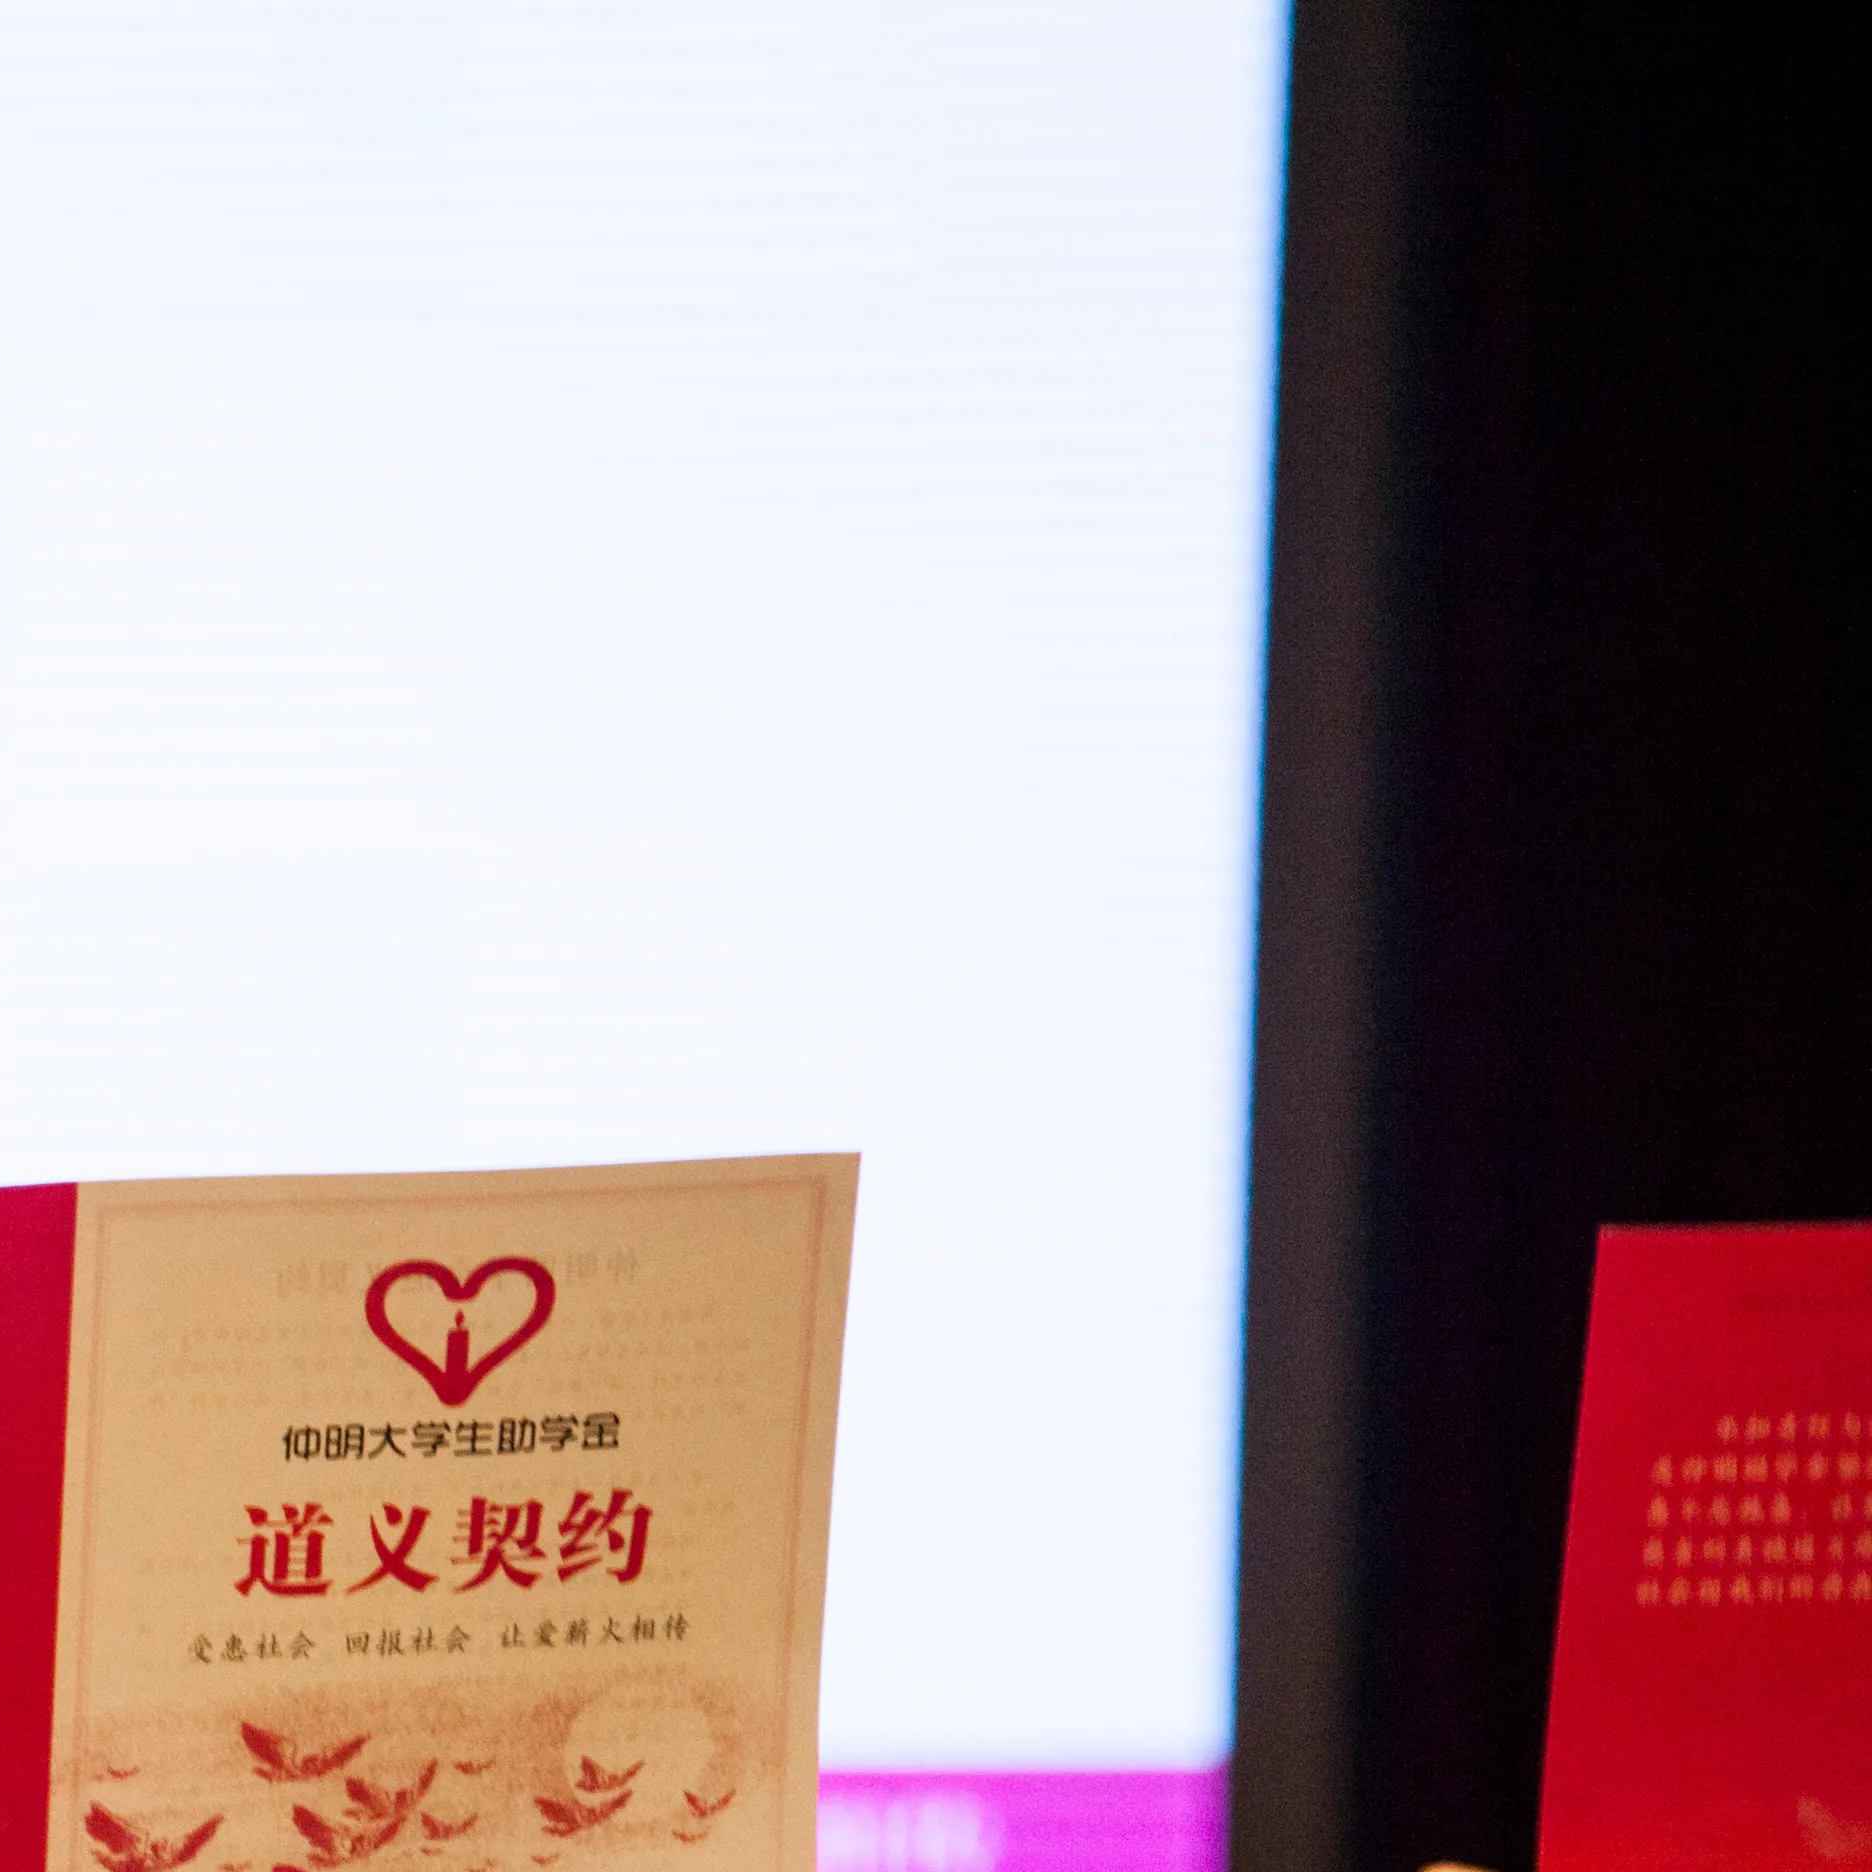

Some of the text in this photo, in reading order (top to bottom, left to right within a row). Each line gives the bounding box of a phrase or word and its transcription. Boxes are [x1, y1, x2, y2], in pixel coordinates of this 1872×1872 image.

[282, 1410, 622, 1462] 仲明大学生助学金
[234, 1488, 654, 1598] 道义契约
[190, 1612, 689, 1666] 受惠社会 回报社会 让爱薪火相传
